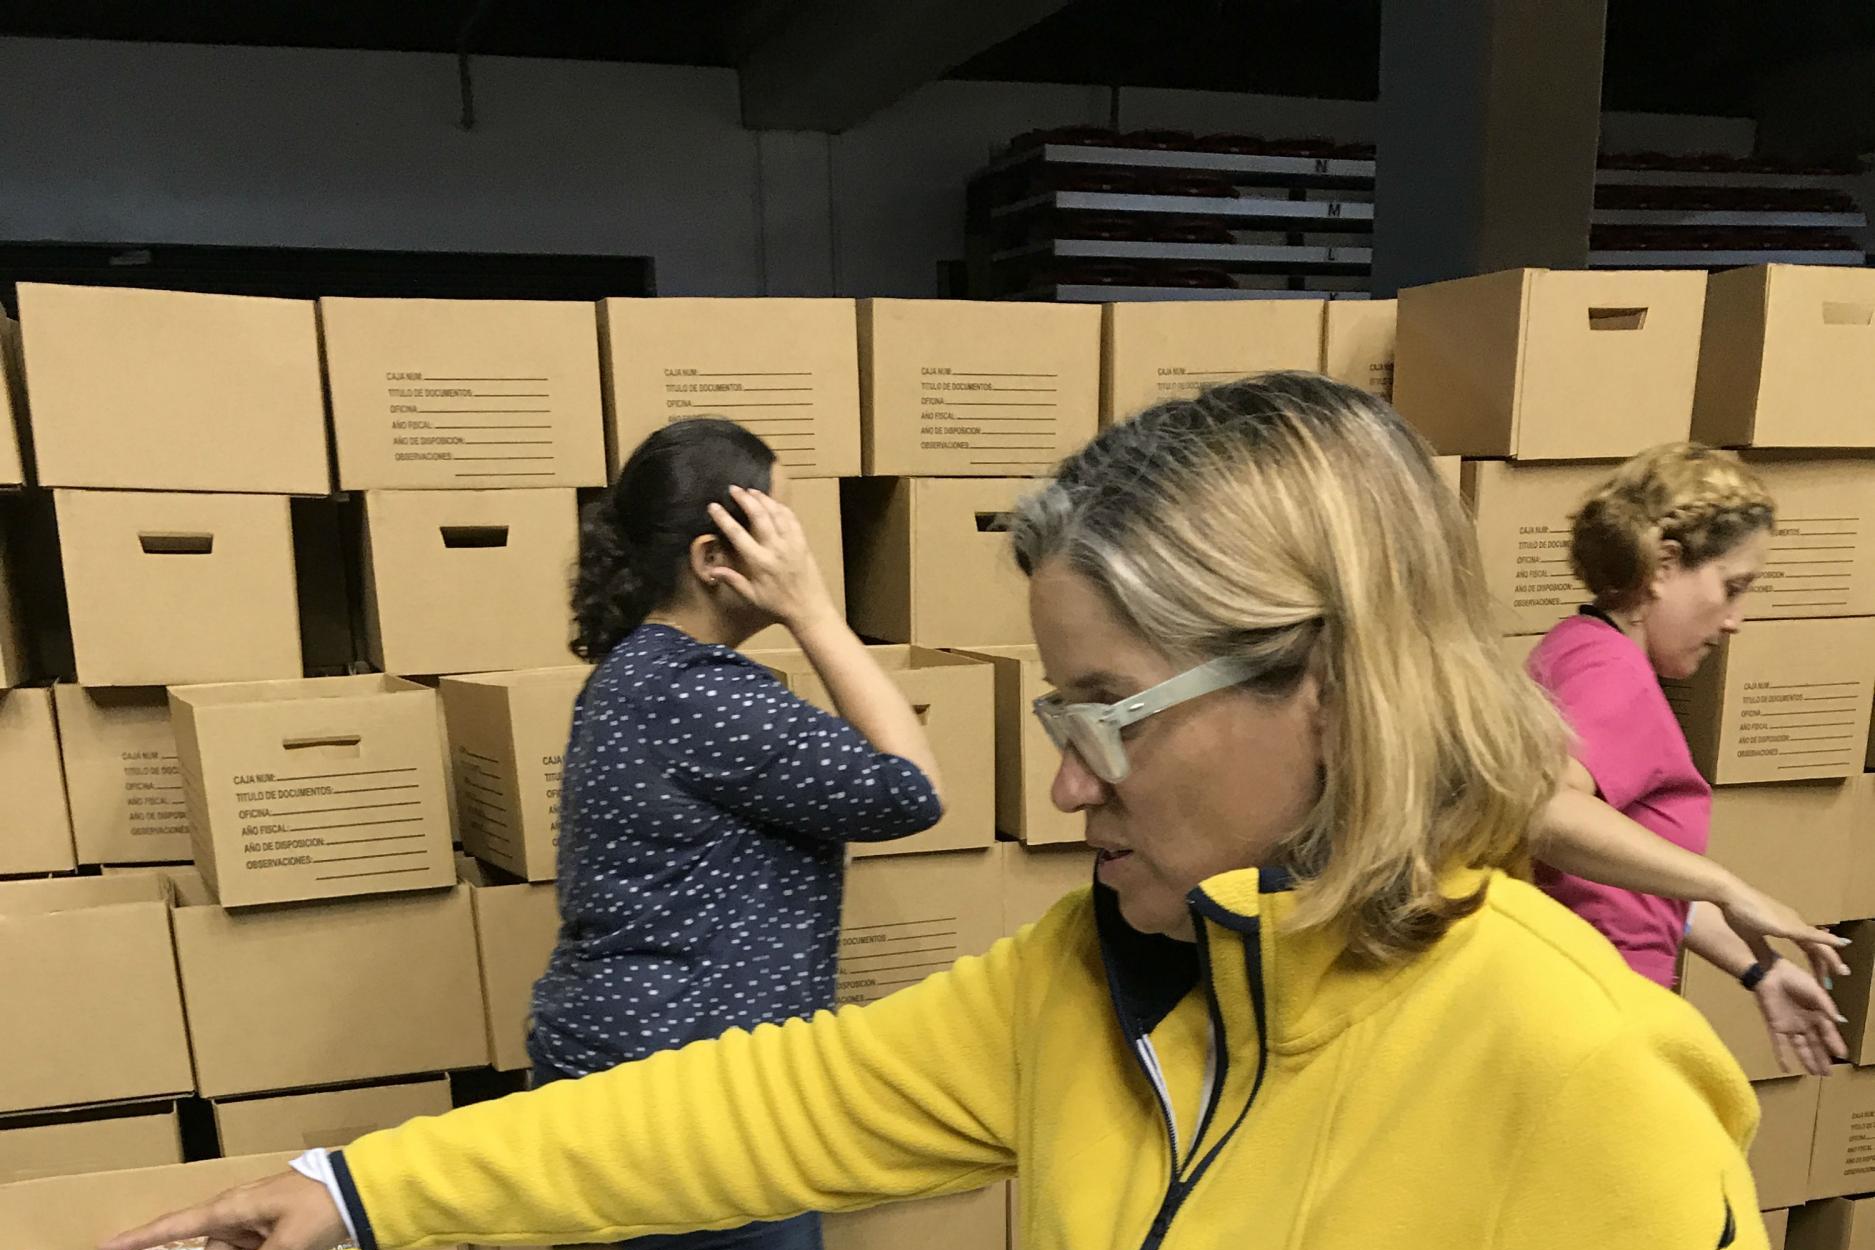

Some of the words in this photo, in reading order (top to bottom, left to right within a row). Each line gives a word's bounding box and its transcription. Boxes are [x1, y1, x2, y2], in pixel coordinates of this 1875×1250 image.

[1315, 160, 1328, 172] N
[1328, 203, 1341, 216] M
[1328, 248, 1335, 261] L
[233, 775, 255, 785] CAJA
[265, 791, 277, 800] DE
[262, 841, 274, 851] DE
